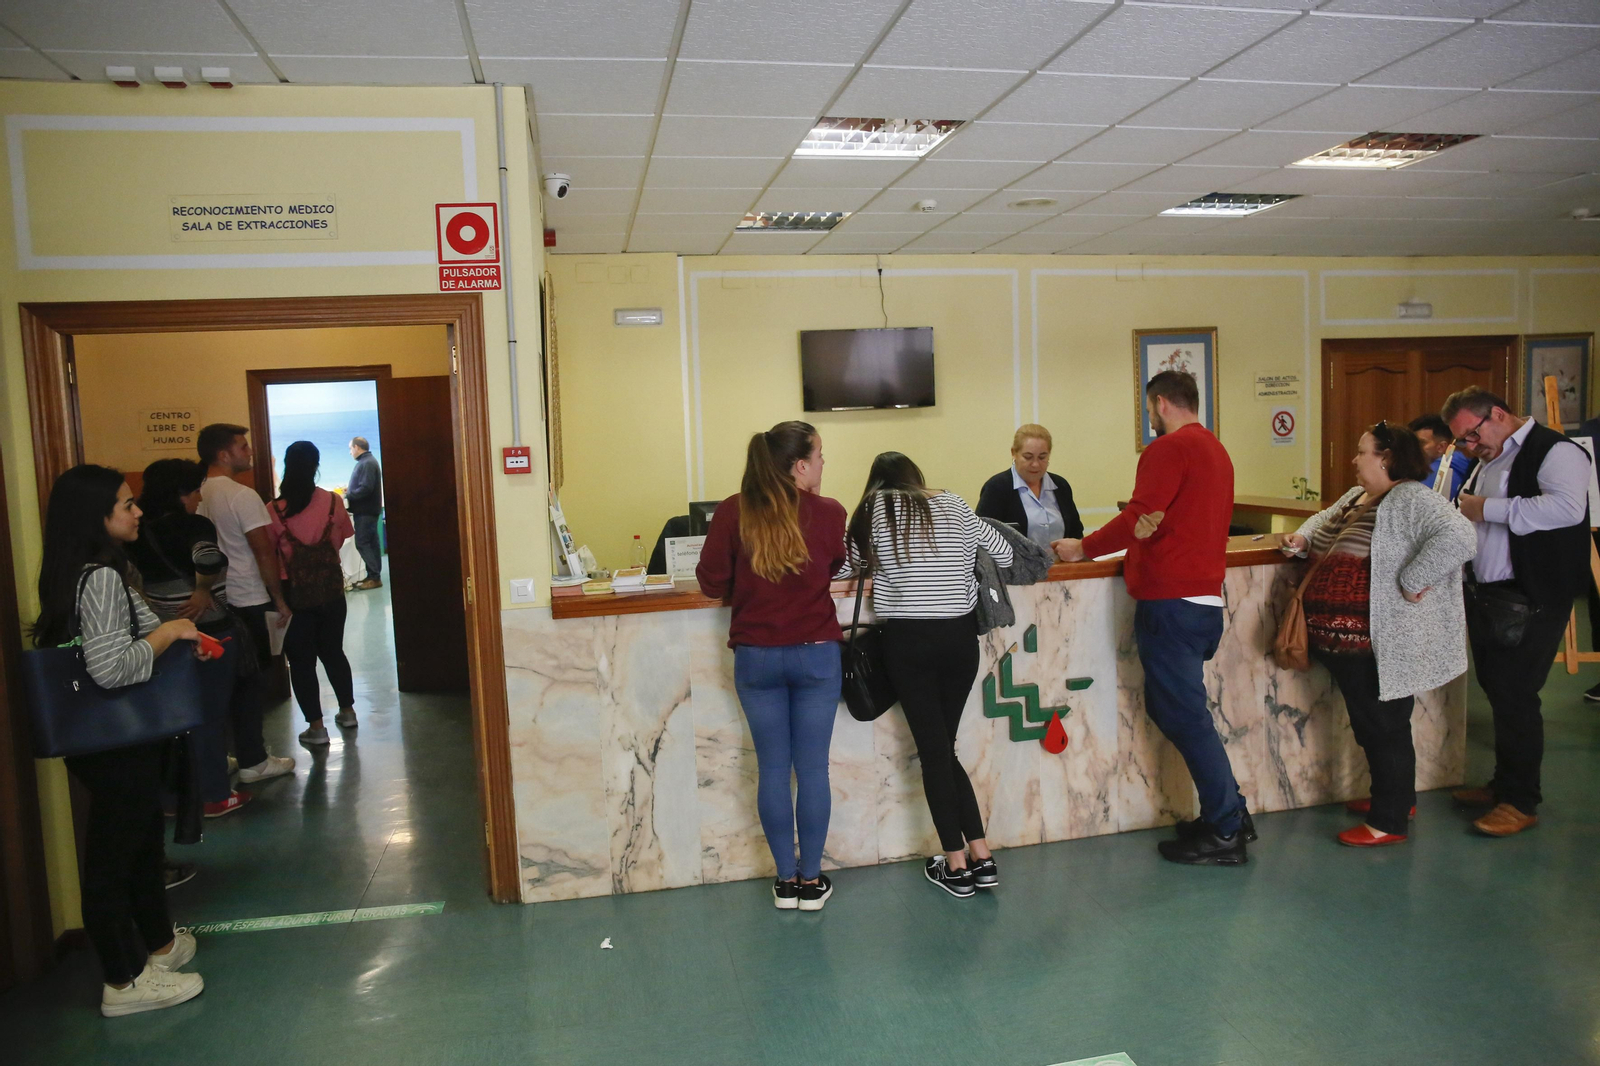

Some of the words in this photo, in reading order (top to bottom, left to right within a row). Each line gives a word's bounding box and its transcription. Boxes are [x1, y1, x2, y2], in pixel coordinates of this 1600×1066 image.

[172, 205, 283, 216] RECONOCIMIENTO
[288, 204, 335, 214] MEDICO
[181, 222, 212, 231] SALA
[217, 221, 232, 230] DE
[237, 219, 328, 230] EXTRACCIONES
[443, 267, 497, 277] PULSADOR
[442, 280, 456, 289] DE
[457, 280, 500, 288] ALARMA
[147, 424, 177, 432] LIBRE
[195, 922, 233, 934] FAVOR
[232, 918, 275, 930] ESPERE
[303, 914, 320, 923] SU
[361, 907, 407, 919] GRACIAS
